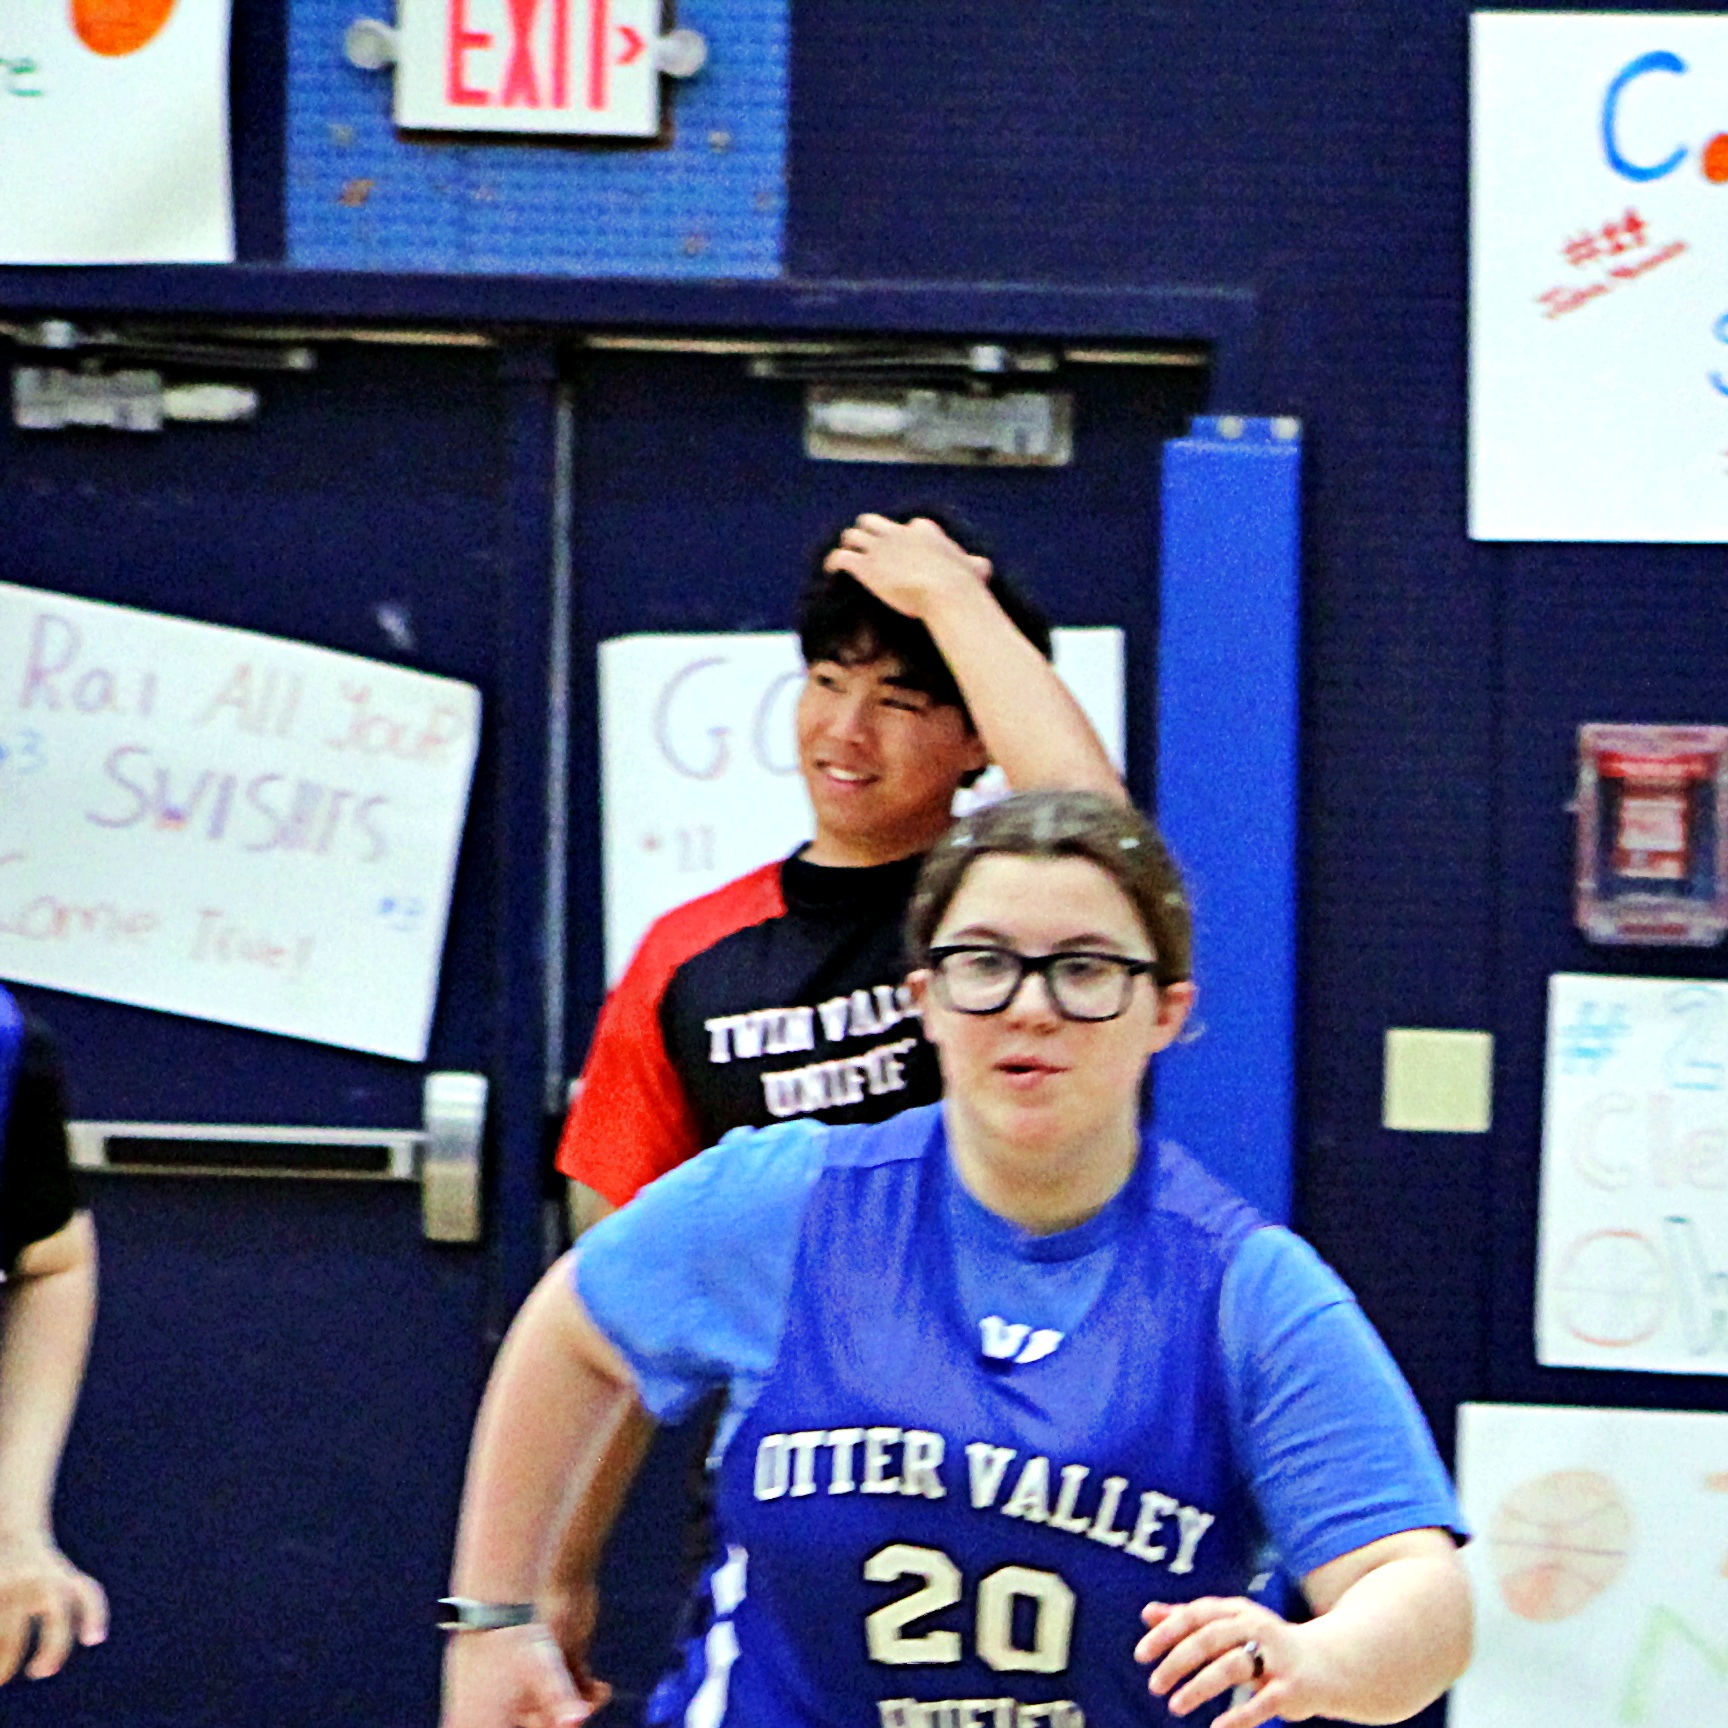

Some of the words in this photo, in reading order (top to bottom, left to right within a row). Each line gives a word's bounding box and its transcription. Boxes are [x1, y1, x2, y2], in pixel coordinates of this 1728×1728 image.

[443, 0, 611, 110] EXIT
[963, 1440, 1215, 1576] VALLEY
[862, 1542, 1077, 1675] 20
